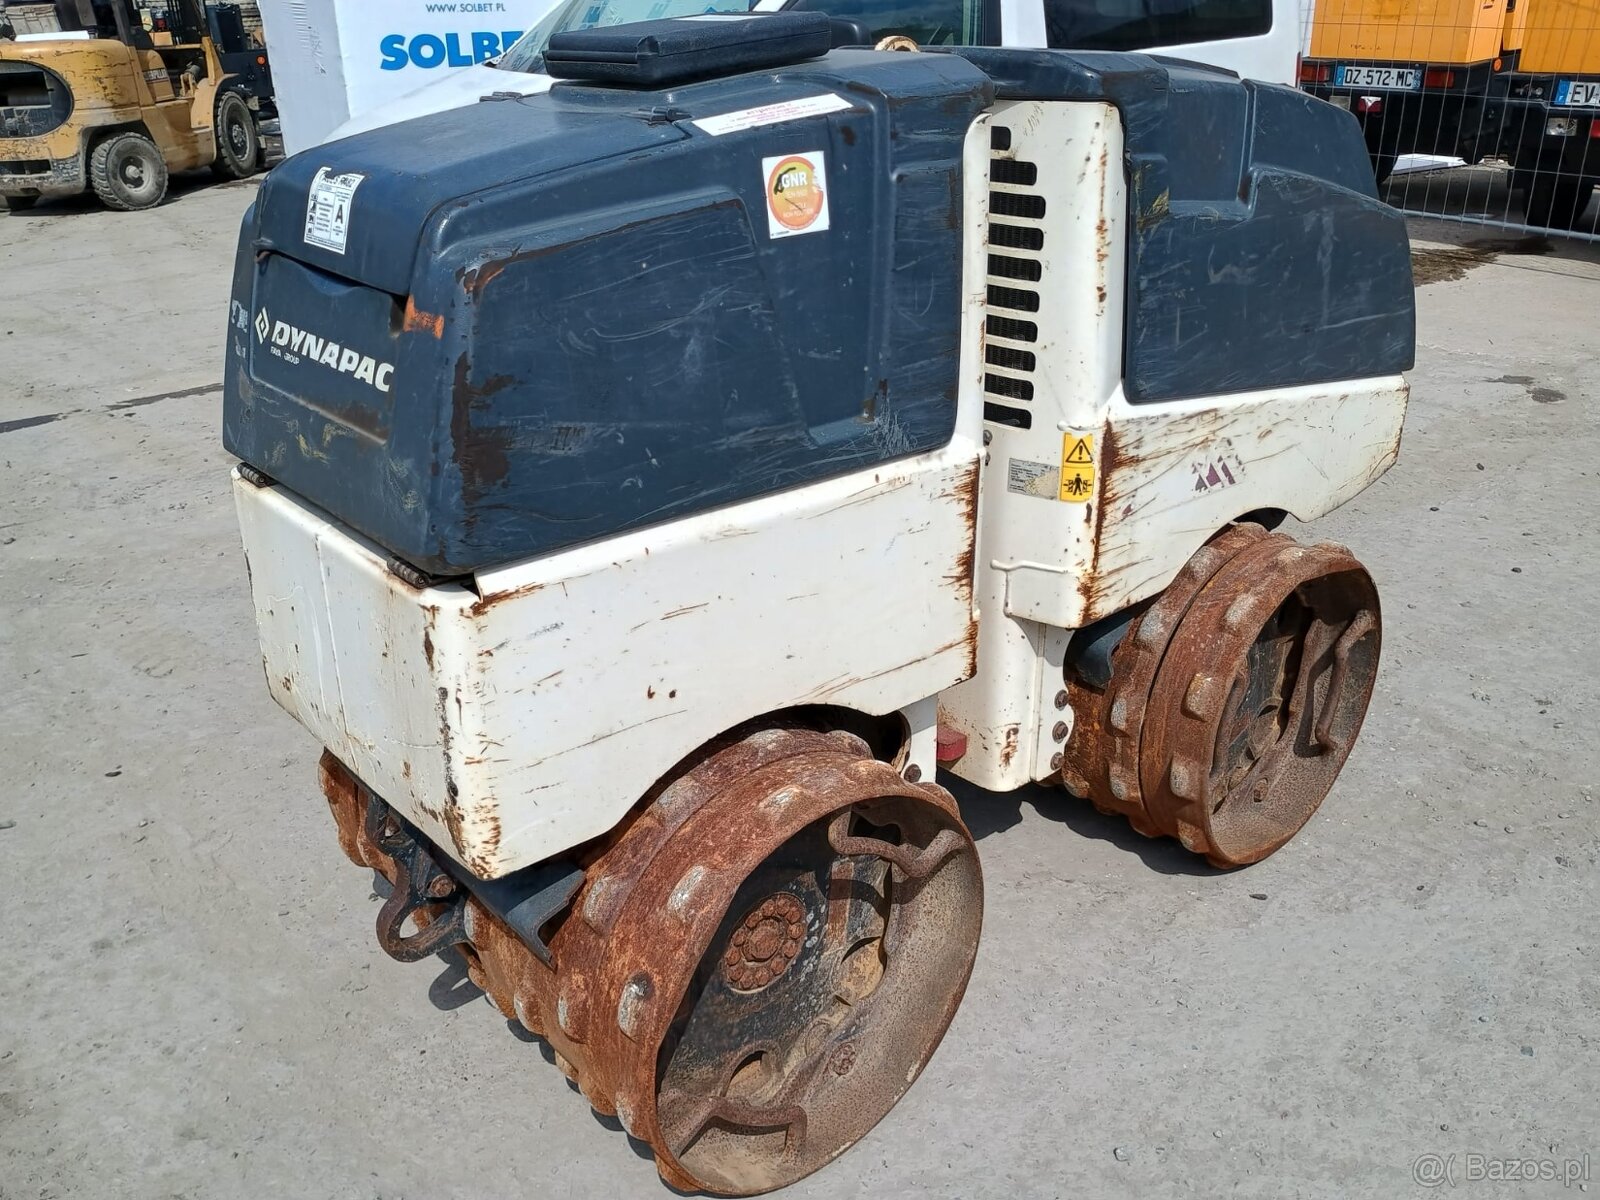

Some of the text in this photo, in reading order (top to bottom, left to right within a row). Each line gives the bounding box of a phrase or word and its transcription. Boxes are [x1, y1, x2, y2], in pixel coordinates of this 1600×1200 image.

[781, 171, 808, 188] GNR
[335, 204, 343, 224] A
[271, 320, 395, 393] DYNAPAC
